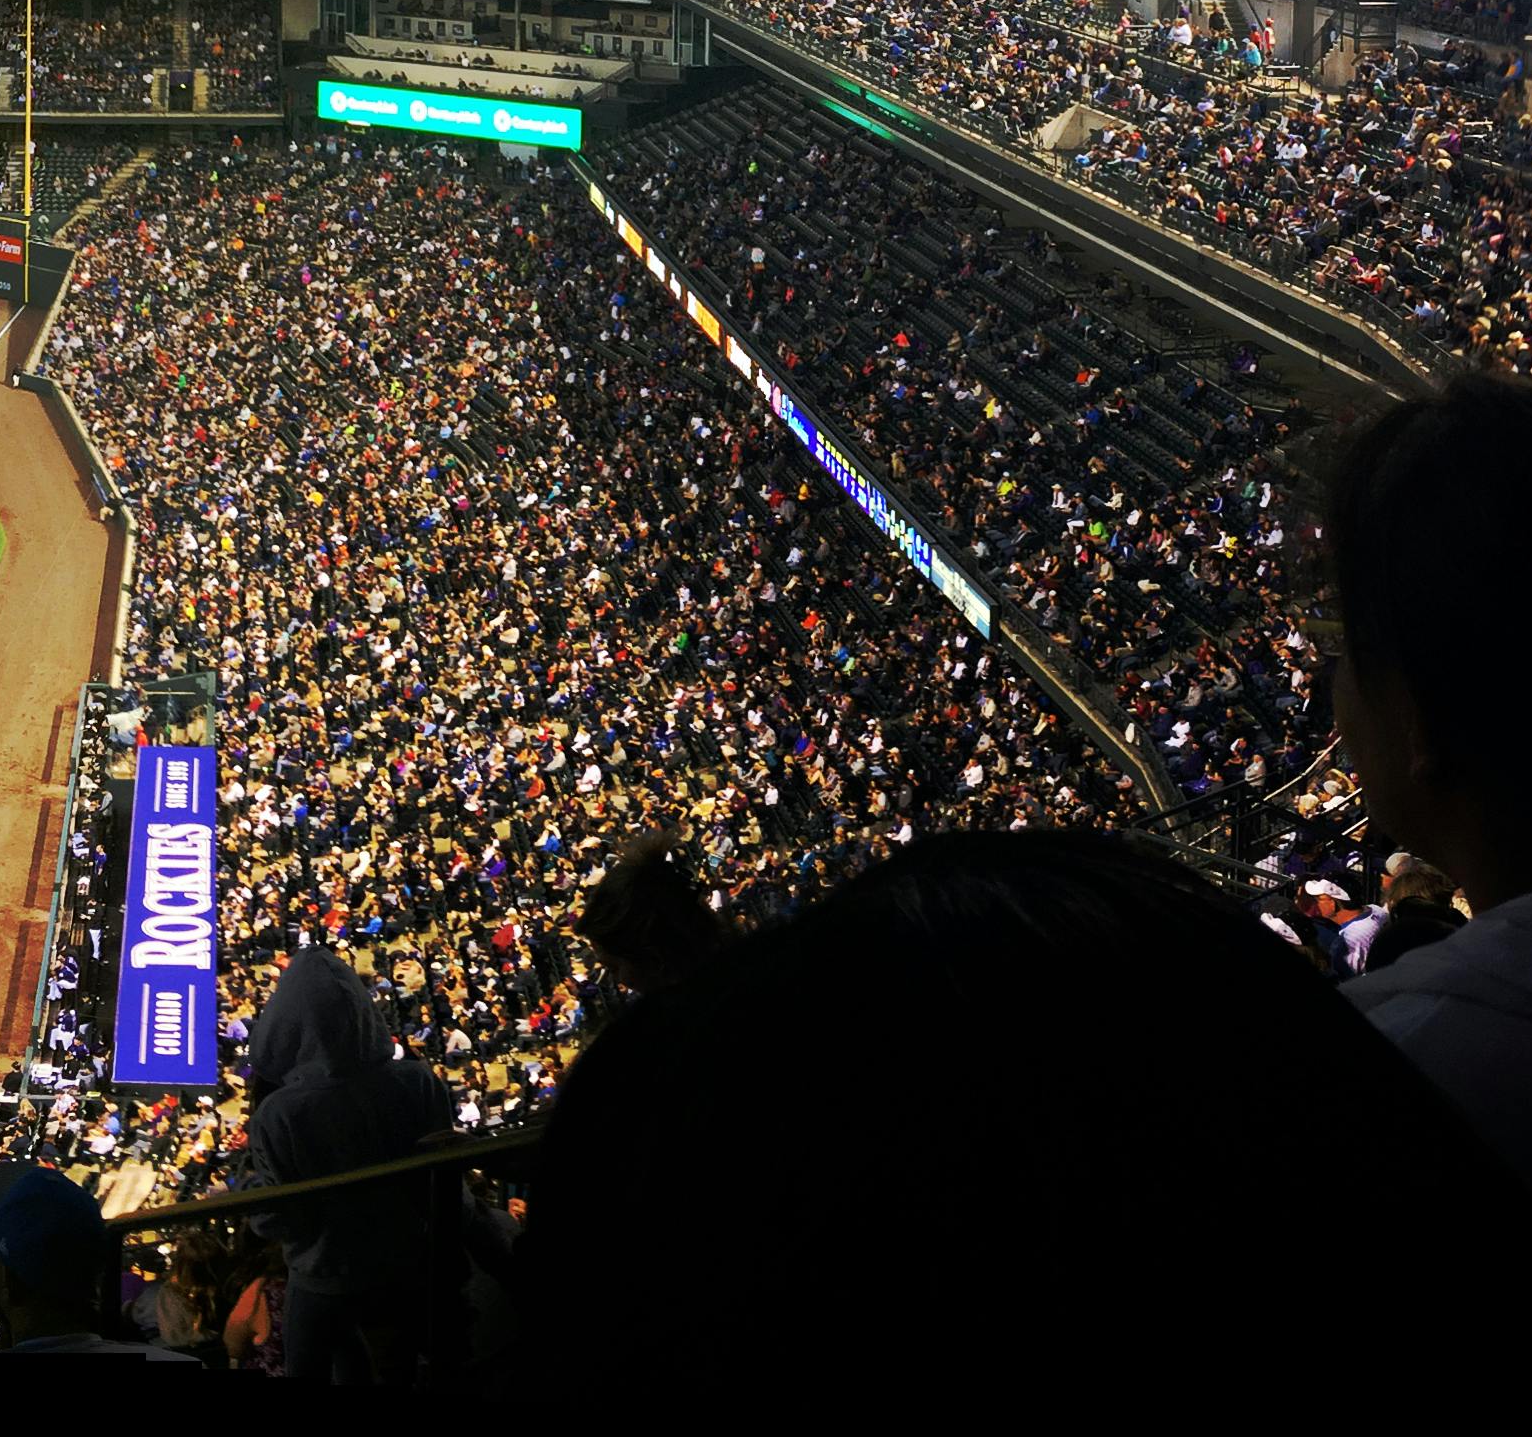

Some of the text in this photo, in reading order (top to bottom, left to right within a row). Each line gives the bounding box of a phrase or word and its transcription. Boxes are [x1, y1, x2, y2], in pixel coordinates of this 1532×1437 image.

[165, 783, 188, 809] SINCE
[131, 823, 213, 970] ROCKIES
[153, 991, 183, 1056] COLORADO
